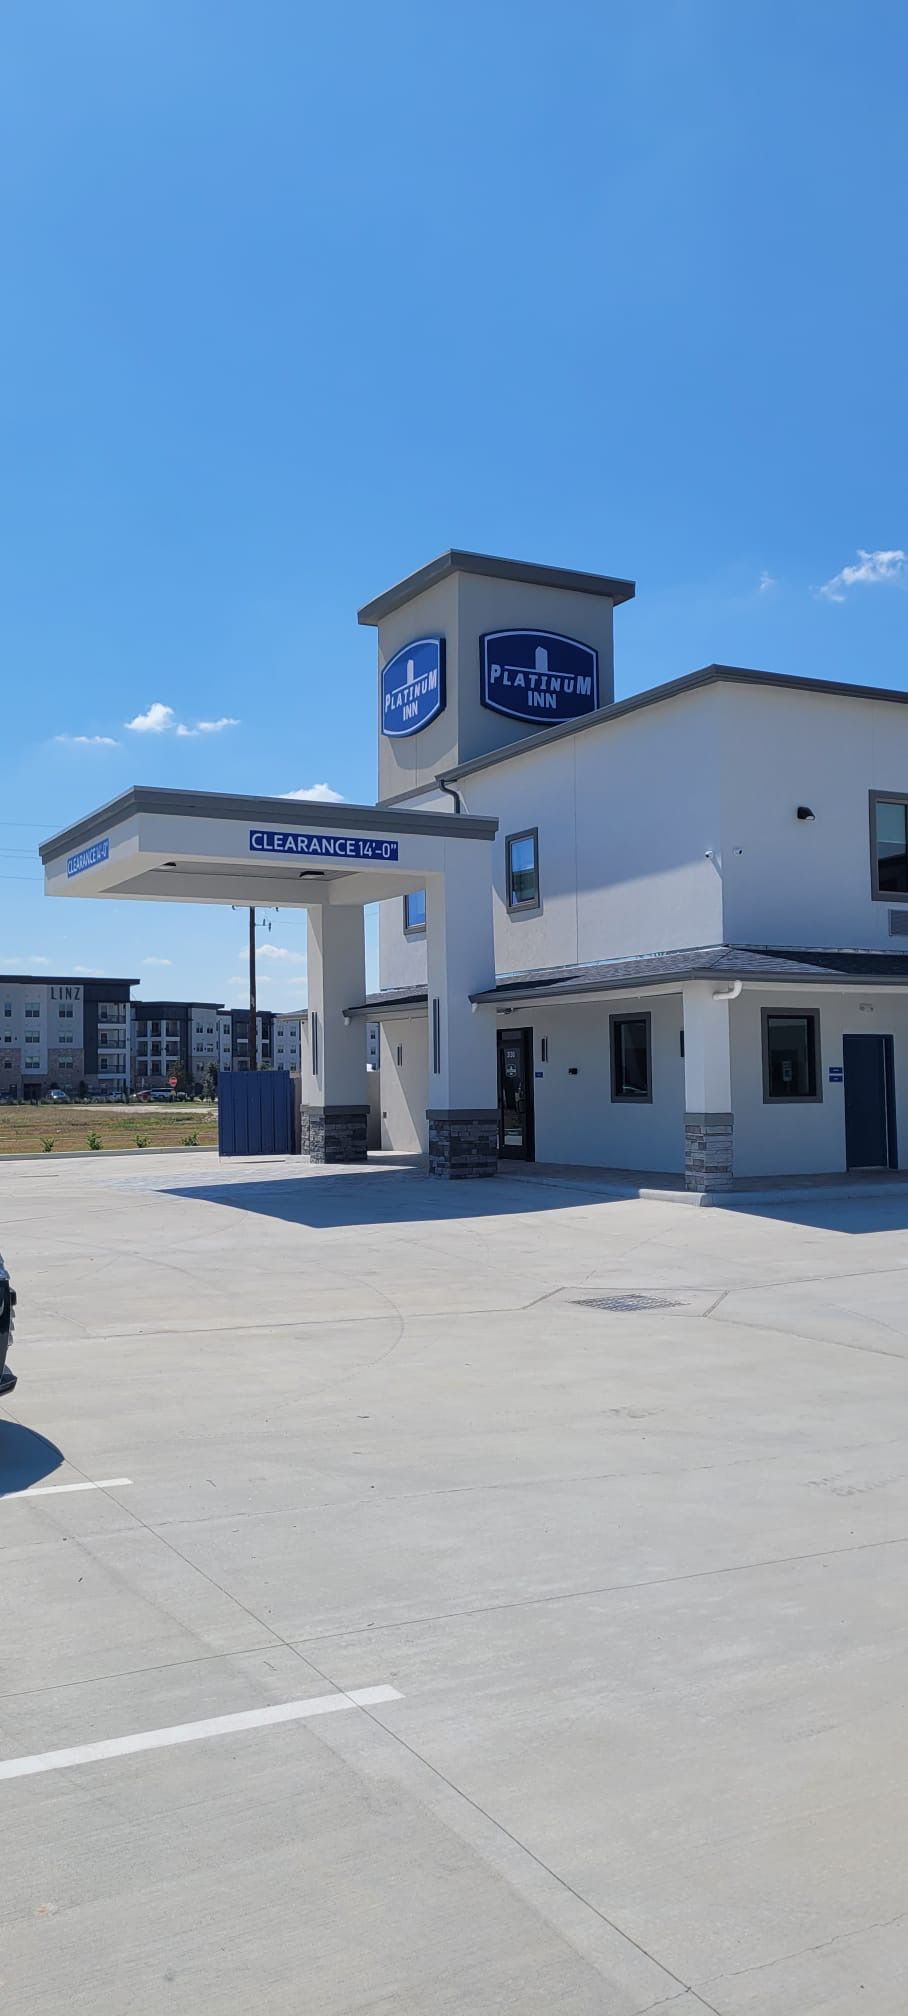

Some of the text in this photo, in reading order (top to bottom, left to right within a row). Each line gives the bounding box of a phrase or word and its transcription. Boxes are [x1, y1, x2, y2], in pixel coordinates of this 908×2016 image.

[385, 668, 437, 712] PLATINUM
[490, 664, 592, 696] PLATINUM
[527, 690, 557, 709] INN
[402, 700, 418, 721] INN
[251, 833, 356, 855] CLEARANCE
[51, 986, 80, 1000] LINZ
